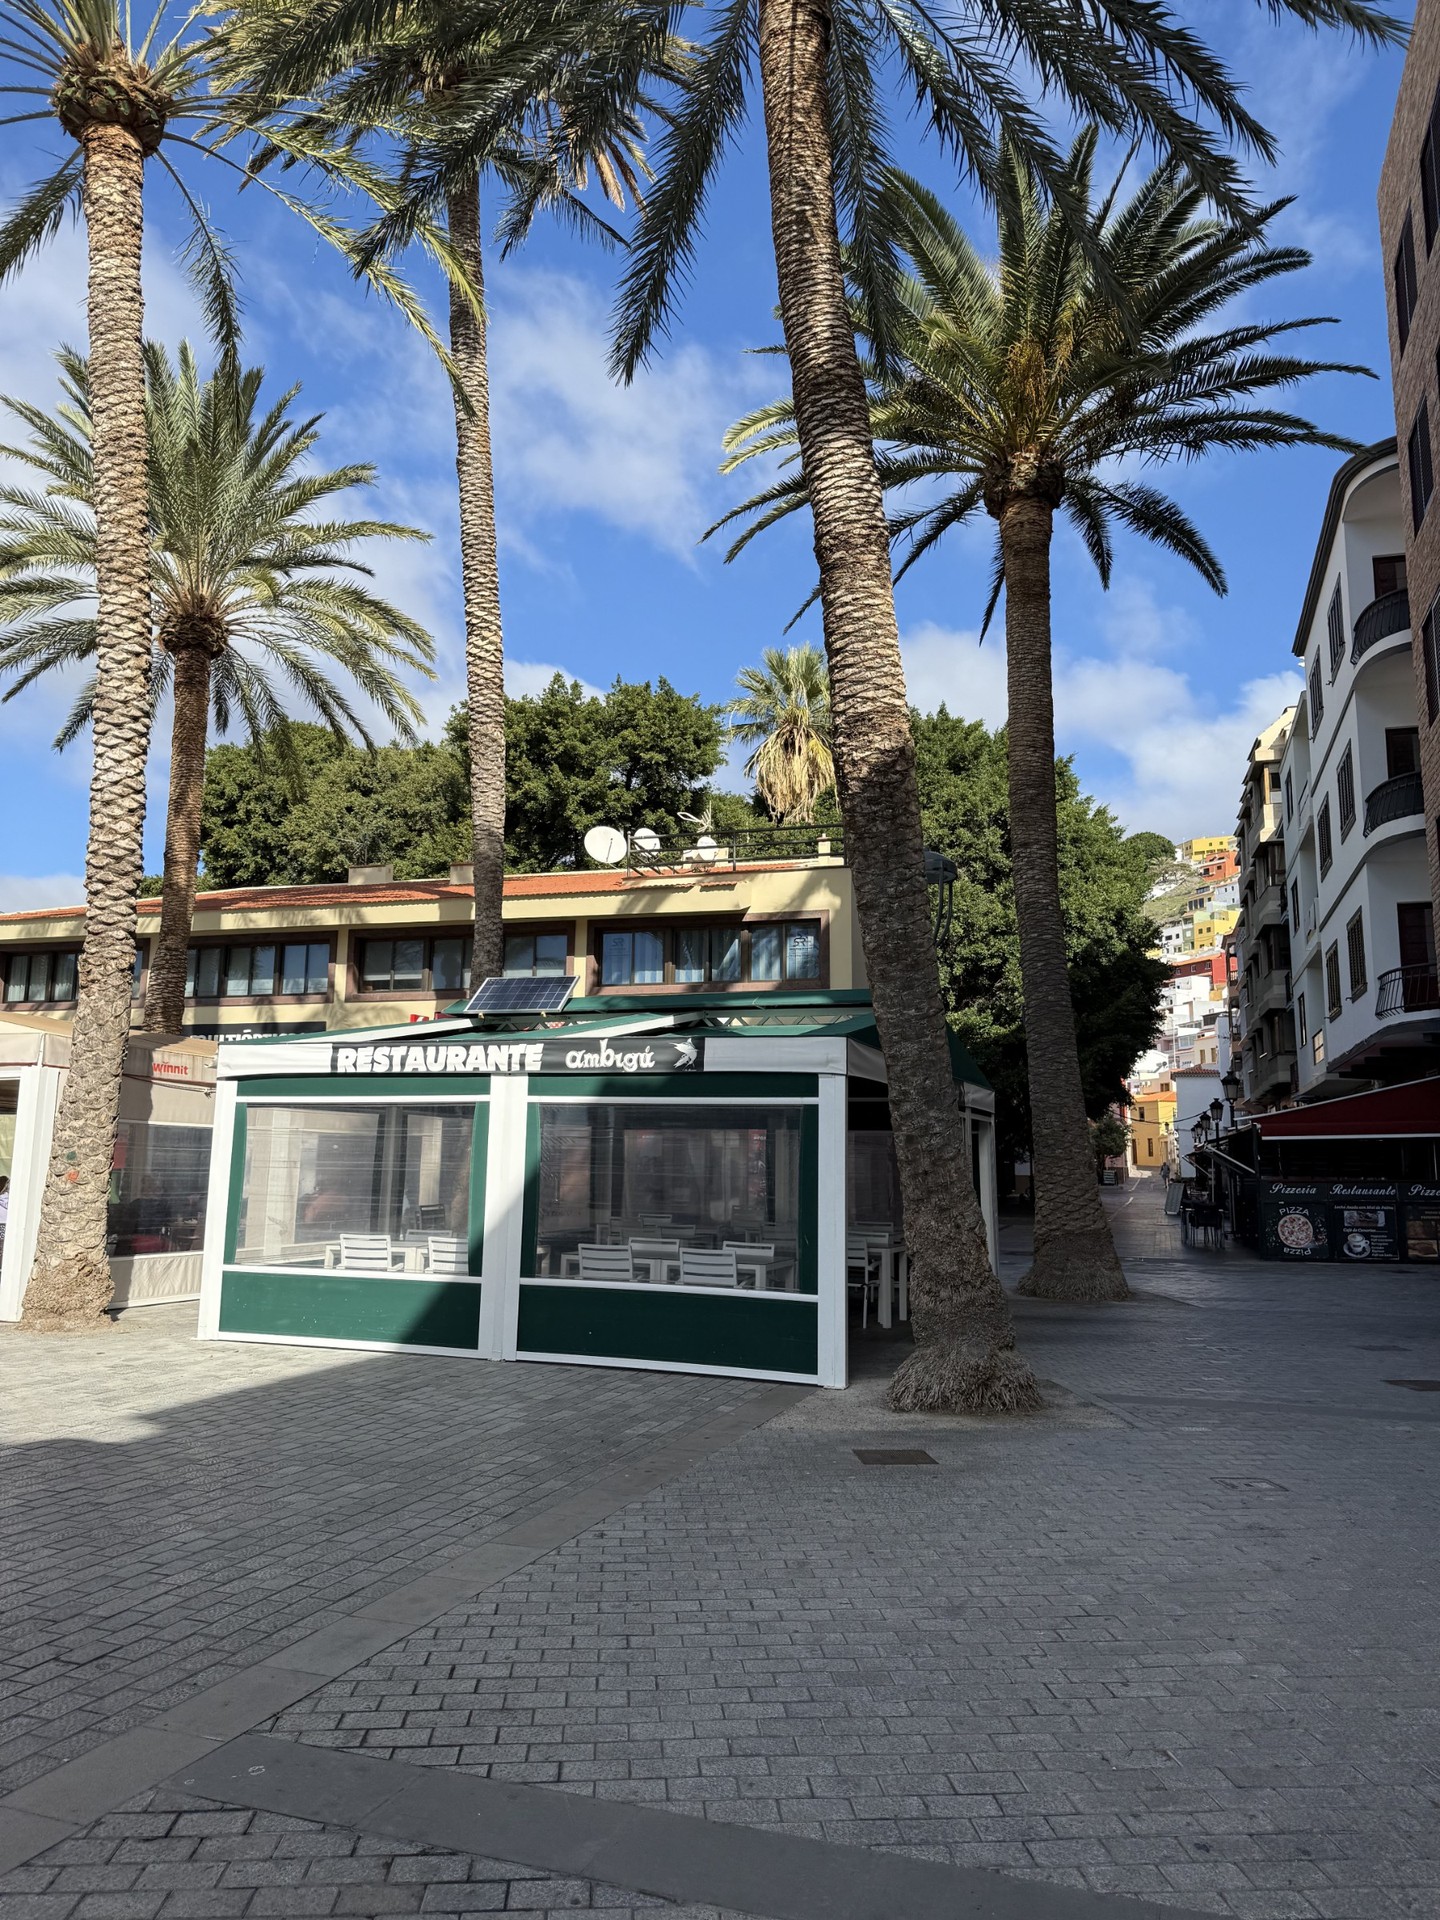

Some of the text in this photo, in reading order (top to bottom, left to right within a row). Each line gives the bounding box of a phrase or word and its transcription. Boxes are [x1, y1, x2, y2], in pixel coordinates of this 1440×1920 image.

[337, 1038, 656, 1073] RESTAURANTE ambigú
[152, 1061, 189, 1075] winnit
[1329, 1183, 1397, 1196] Restaurante
[1279, 1206, 1310, 1216] PIZZA
